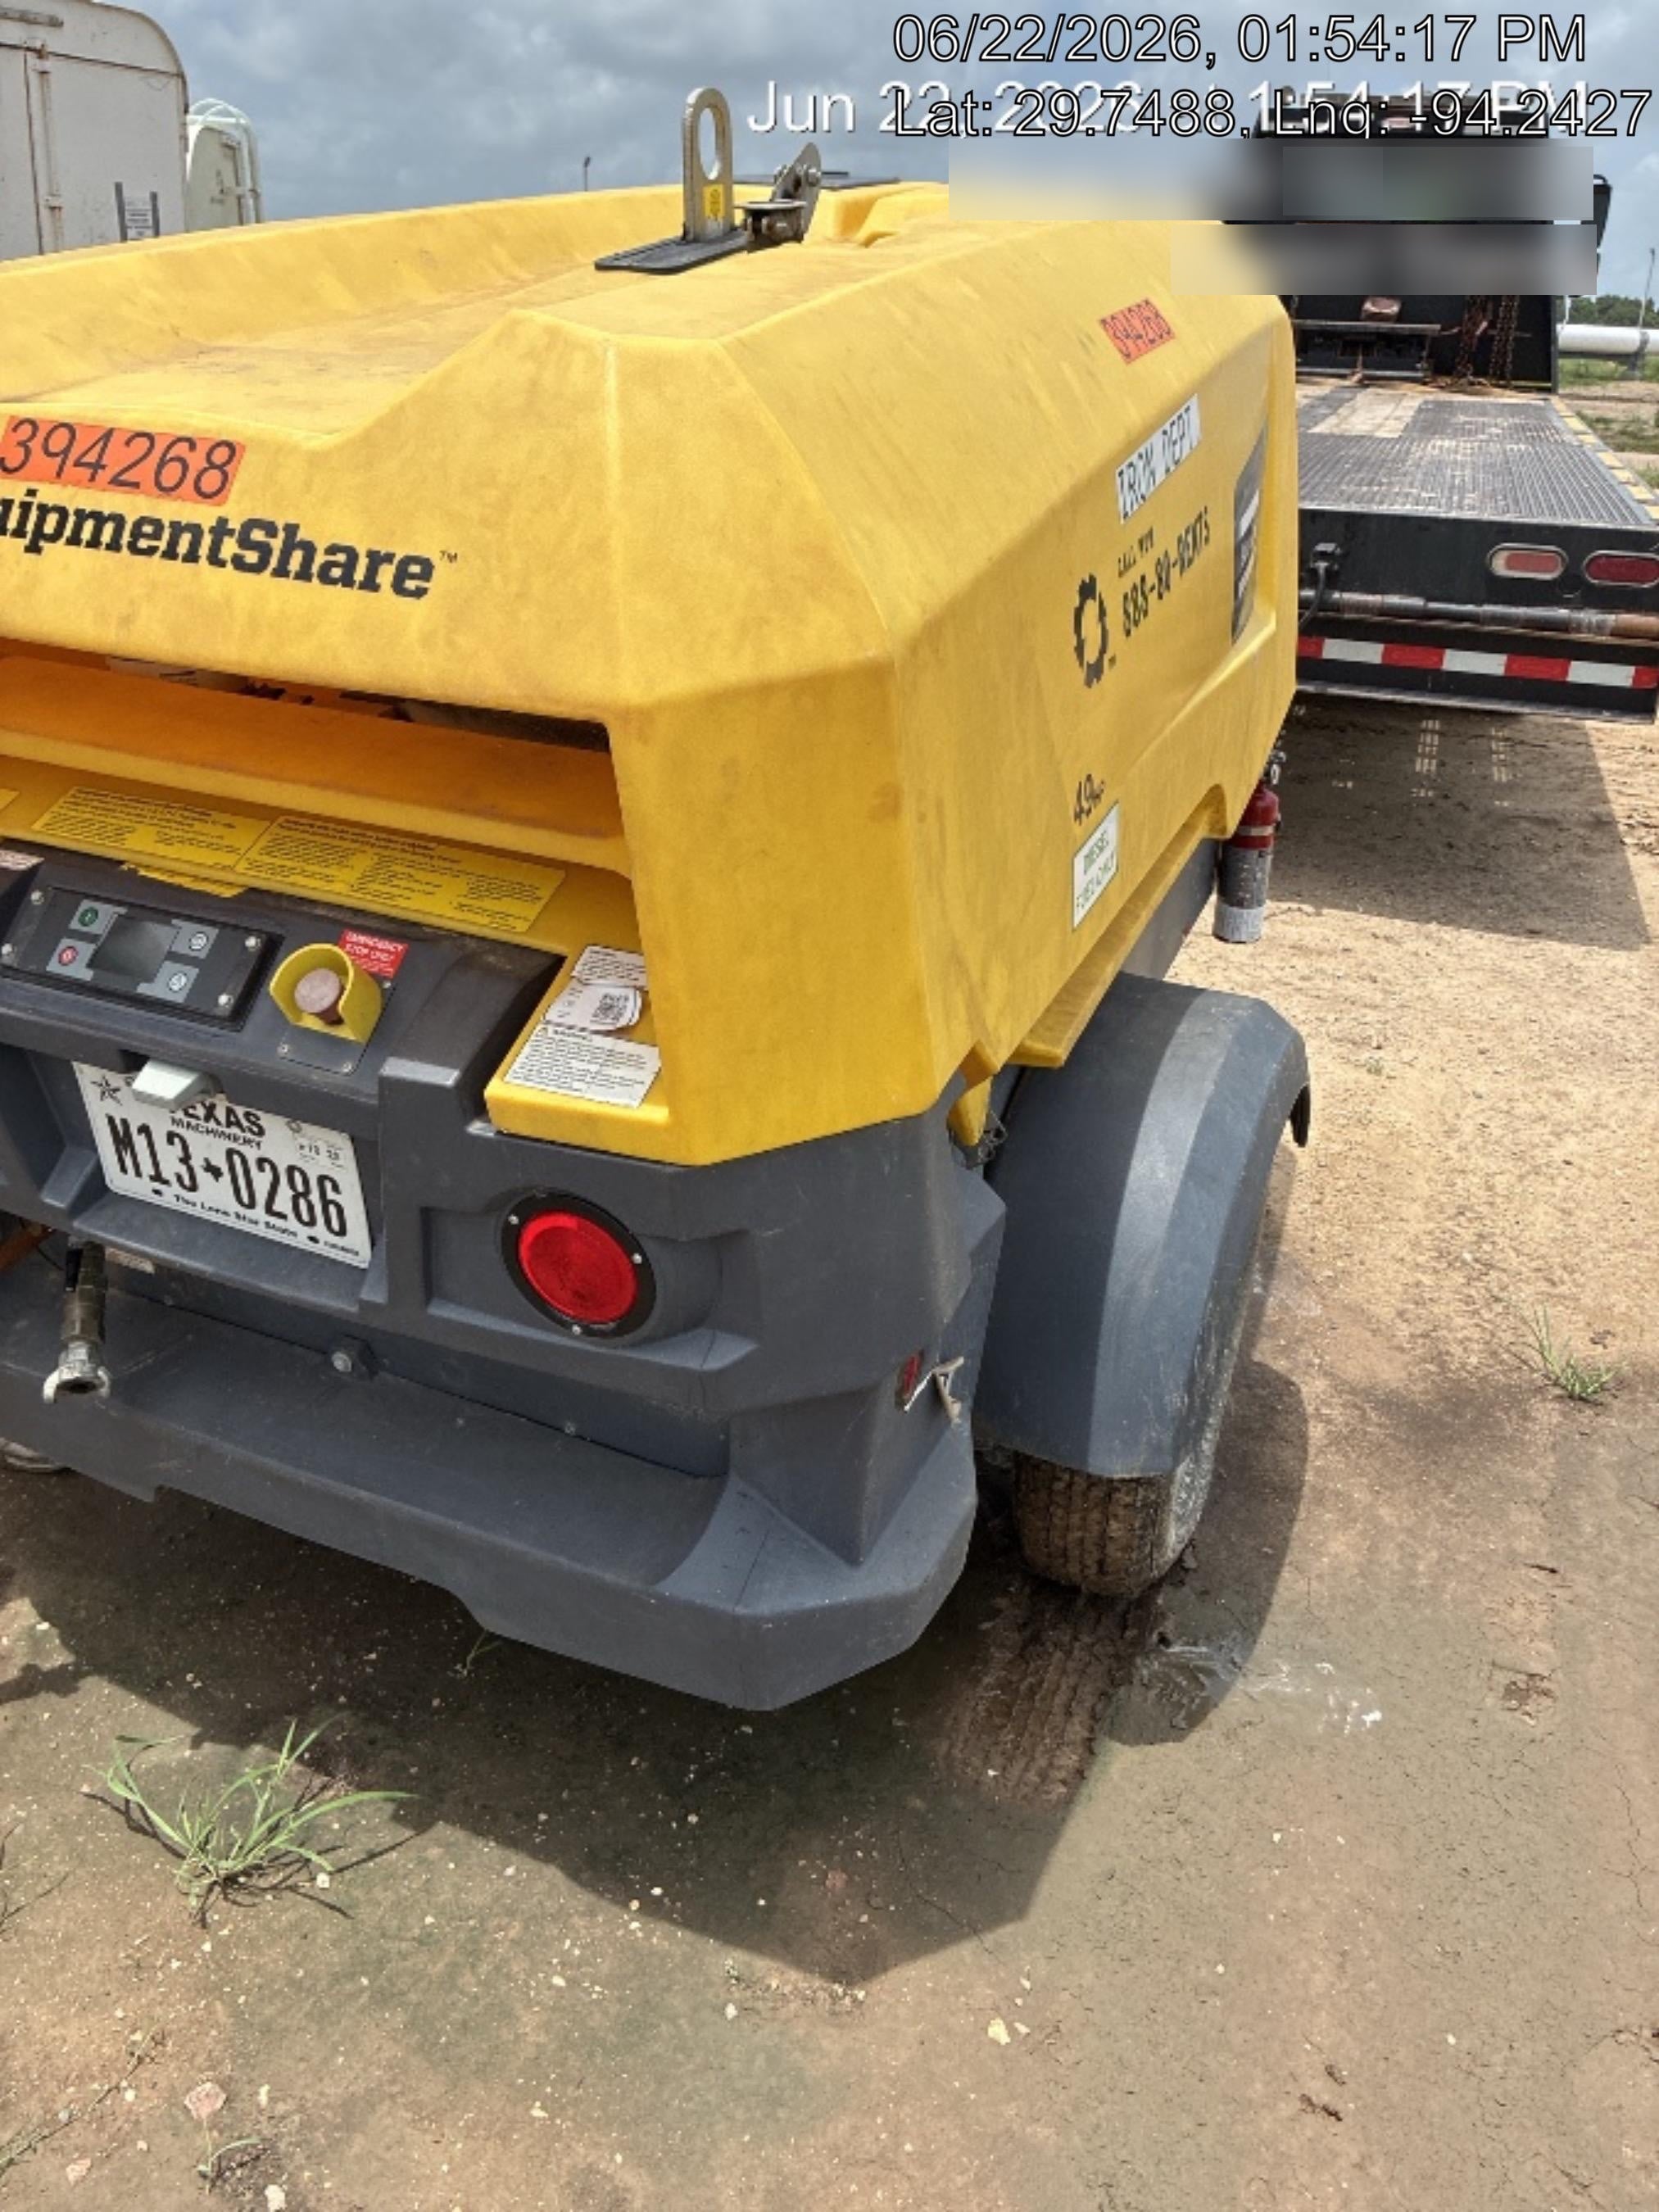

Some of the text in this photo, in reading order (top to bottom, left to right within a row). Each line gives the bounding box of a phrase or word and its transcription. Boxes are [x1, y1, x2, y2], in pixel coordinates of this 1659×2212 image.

[0, 417, 237, 500] 394268
[169, 1100, 266, 1138] EXAS
[170, 1115, 263, 1151] MACHINERY
[173, 1193, 197, 1208] The
[200, 1201, 232, 1218] Lone
[233, 1211, 260, 1227] Star
